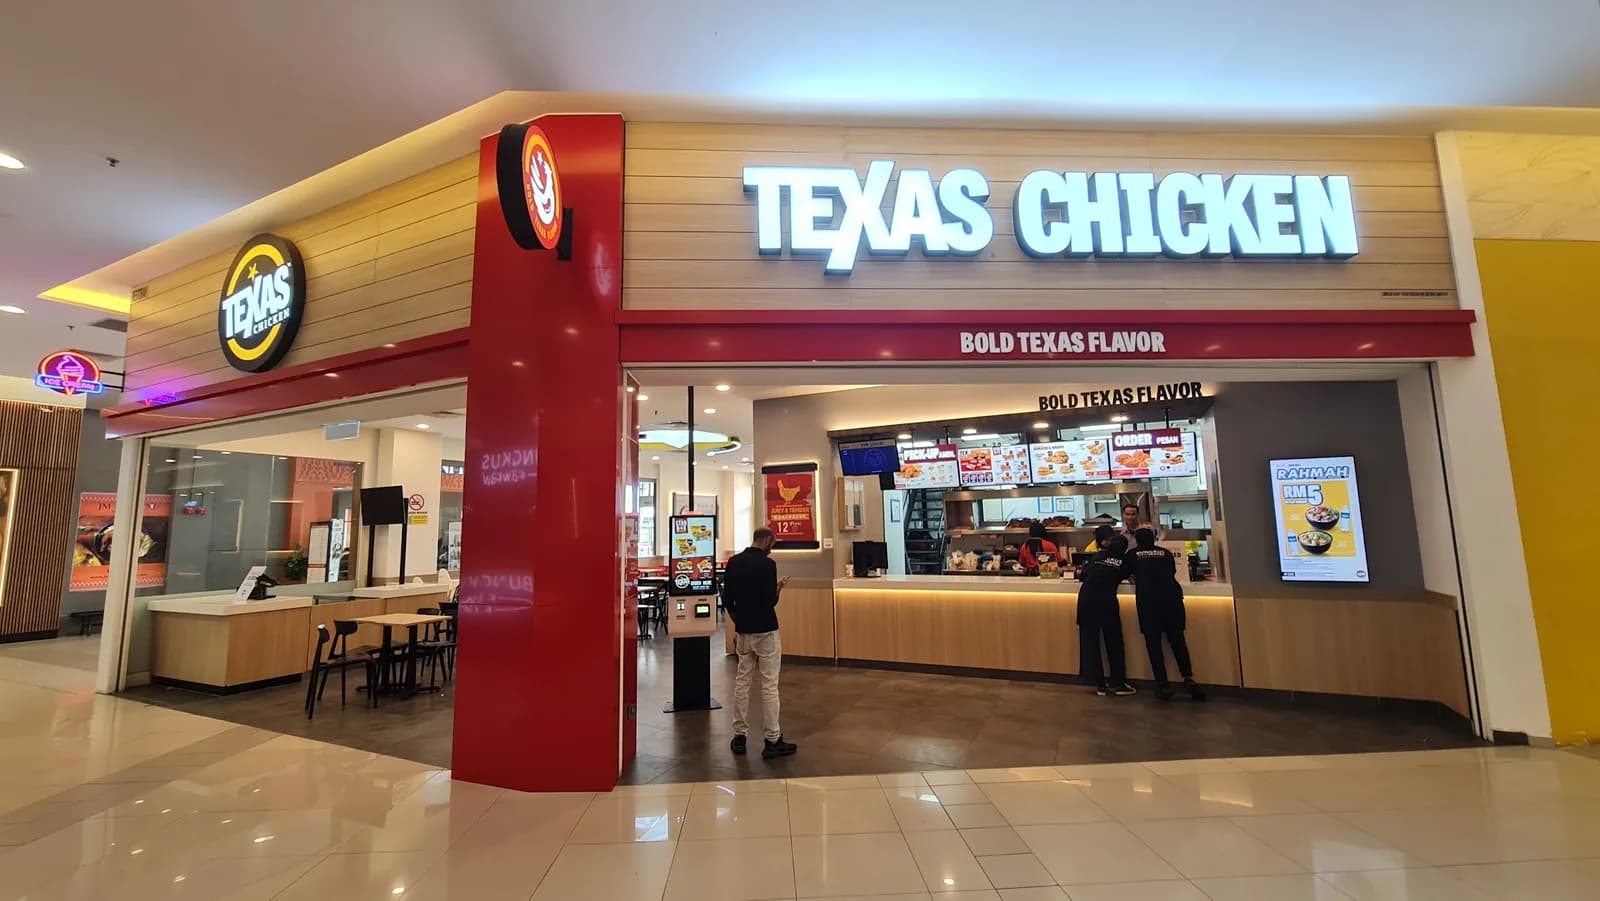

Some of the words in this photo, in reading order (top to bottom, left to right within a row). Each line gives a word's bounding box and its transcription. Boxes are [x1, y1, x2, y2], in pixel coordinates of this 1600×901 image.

[743, 160, 994, 275] TEXAS
[1013, 169, 1359, 258] CHICKEN
[222, 264, 291, 339] TEXAS
[253, 307, 290, 335] CHICKEN
[960, 331, 1014, 354] BOLD
[1017, 331, 1085, 353] TEXAS
[1088, 331, 1166, 353] FLAVOR
[44, 377, 61, 386] ICE
[1038, 394, 1079, 411] BOLD
[1081, 387, 1134, 408] TEXAS
[1136, 381, 1203, 404] FLAVOR
[1114, 433, 1152, 447] ORDER
[1277, 466, 1350, 480] RAHMAH
[777, 521, 789, 533] 12
